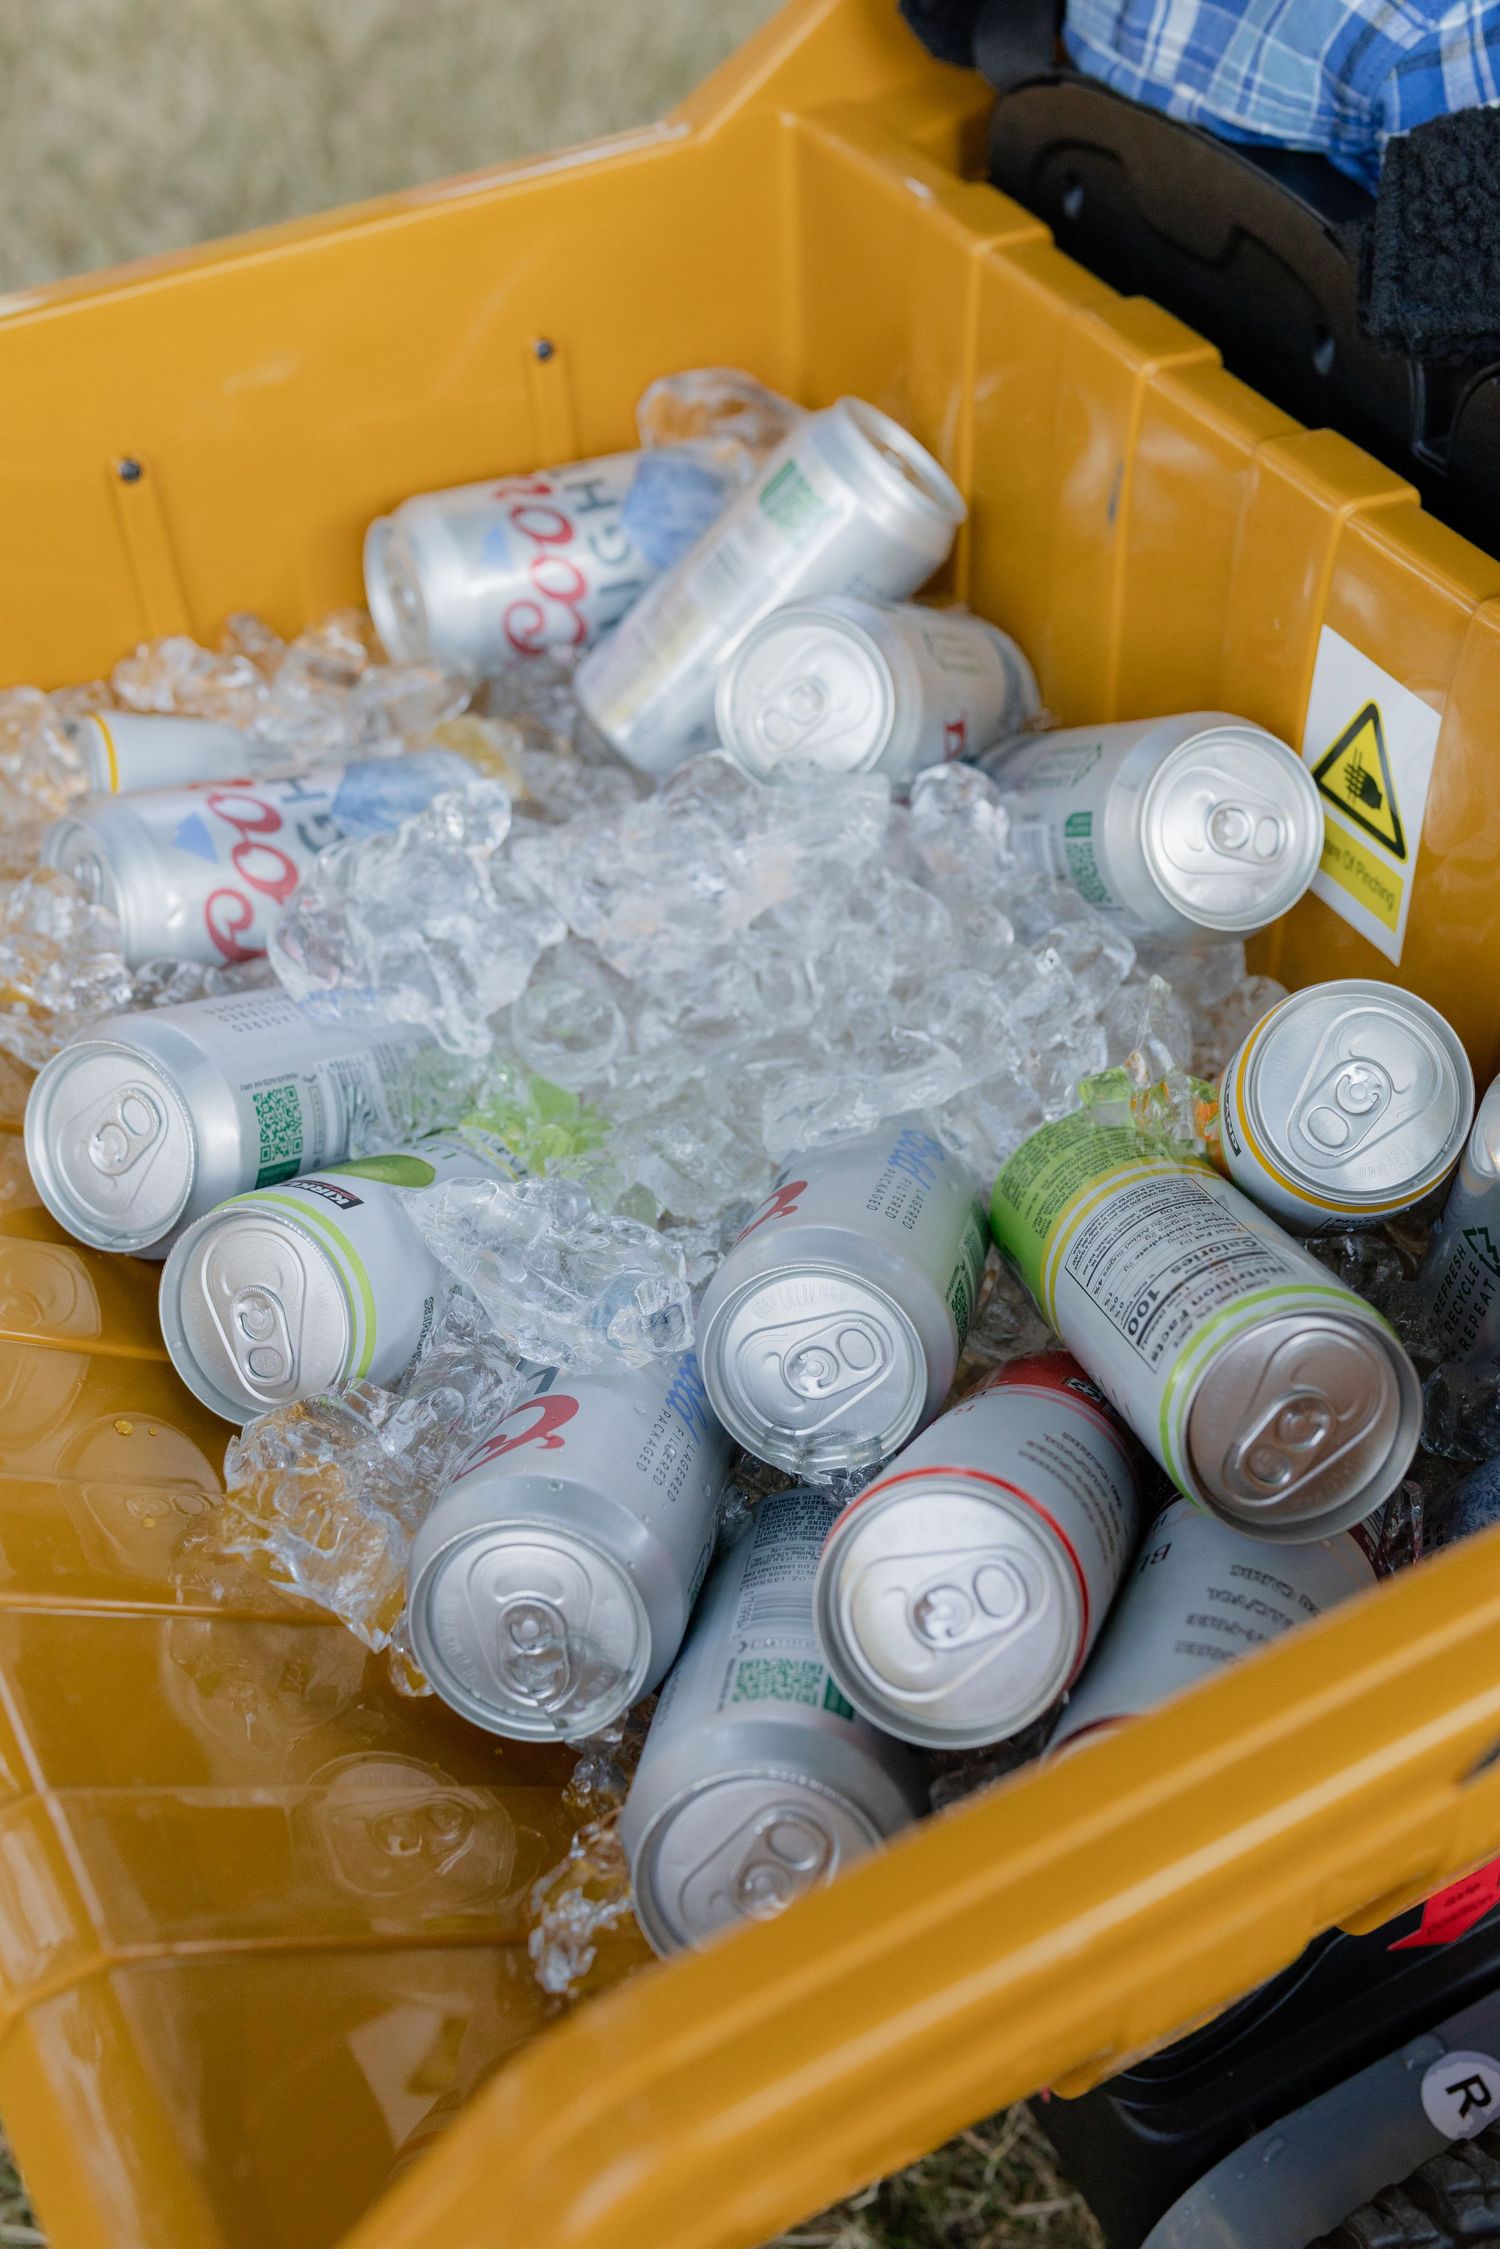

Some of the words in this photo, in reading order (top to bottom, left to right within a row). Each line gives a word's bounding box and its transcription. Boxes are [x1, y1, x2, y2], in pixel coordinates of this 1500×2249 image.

[866, 1167, 897, 1212] PACKAGED
[885, 1177, 912, 1219] FILTERED
[902, 1189, 927, 1230] LAGERED
[1174, 1200, 1214, 1209] Protein
[1124, 1227, 1148, 1249] Added
[1134, 1220, 1201, 1260] Carbohydrate
[1158, 1215, 1192, 1232] Sugars
[1196, 1222, 1236, 1231] Sodium
[1102, 1248, 1123, 1276] Sugars
[1170, 1240, 1257, 1274] Calories
[1190, 1265, 1287, 1307] Nutrition
[1433, 1243, 1466, 1317] REFRESH
[1443, 1262, 1479, 1336] RECYCLE
[1129, 1289, 1159, 1335] 100
[1457, 1278, 1495, 1352] REPEAT
[1150, 1309, 1189, 1362] Facts
[634, 1408, 672, 1472] PACKAGED
[650, 1425, 686, 1486] FILERED
[665, 1443, 697, 1502] LAGERED
[1445, 2072, 1492, 2119] R
